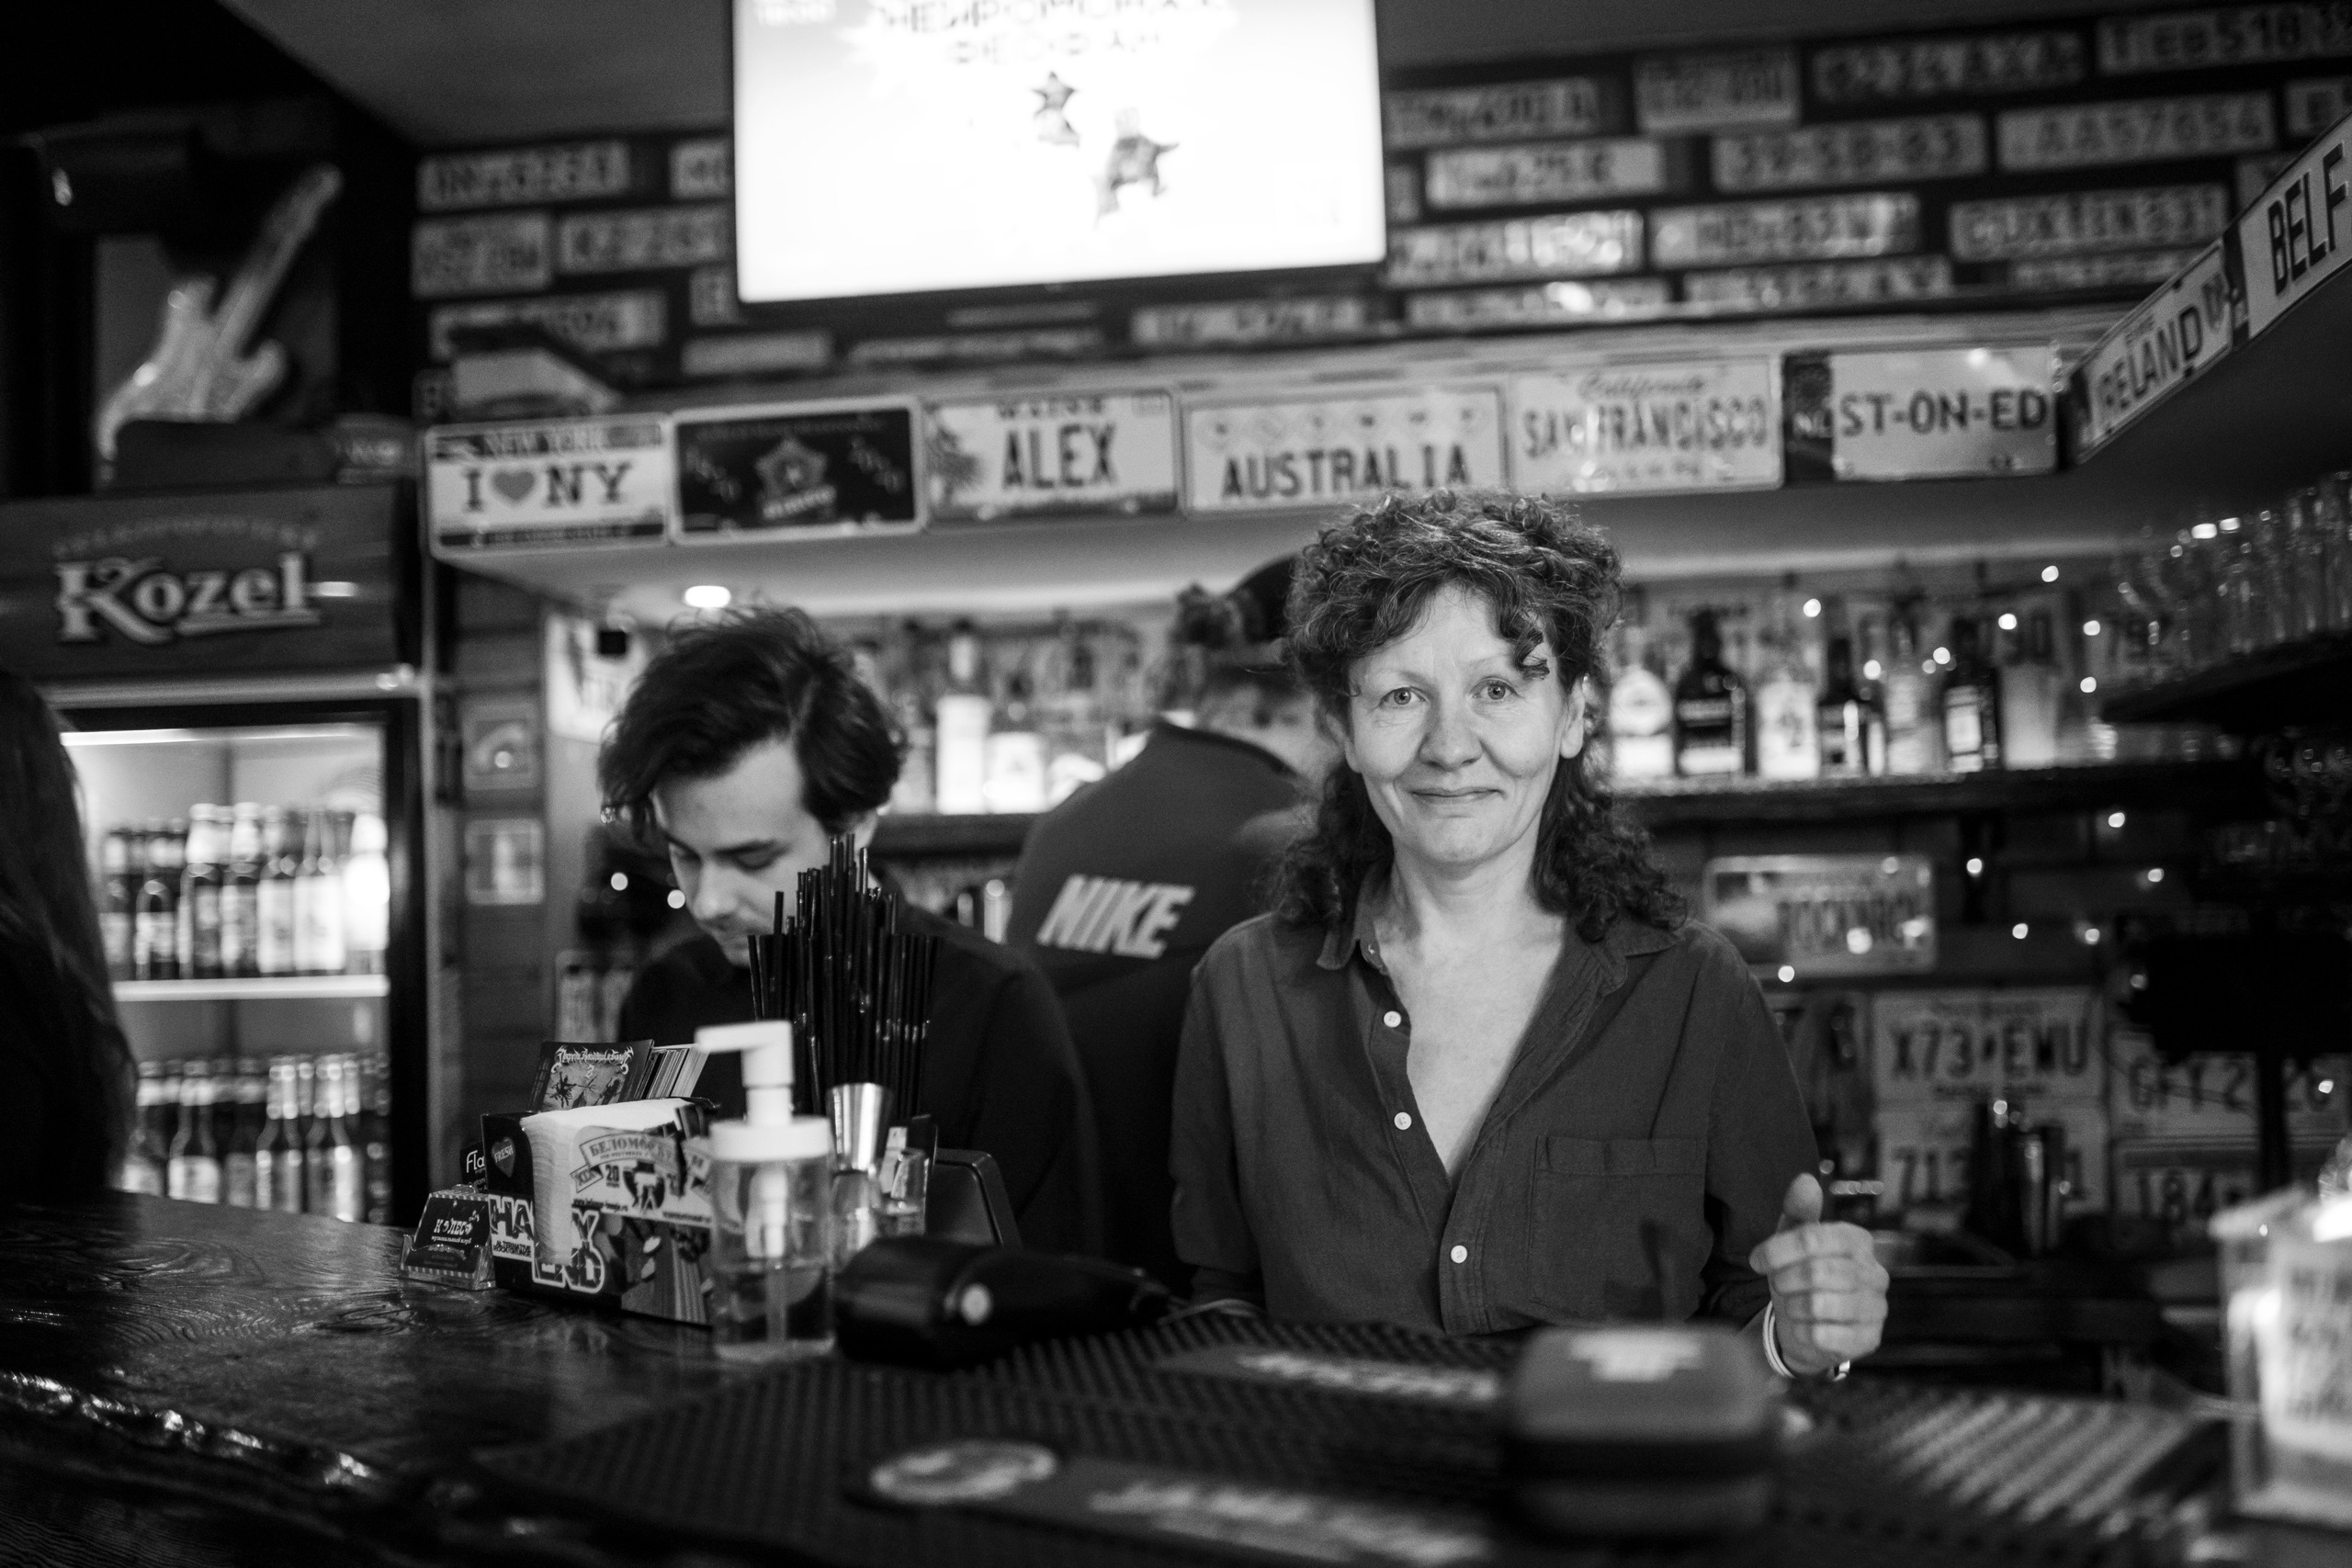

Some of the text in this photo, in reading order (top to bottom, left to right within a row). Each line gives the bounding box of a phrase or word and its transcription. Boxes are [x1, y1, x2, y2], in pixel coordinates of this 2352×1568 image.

[546, 460, 634, 507] NY
[1001, 423, 1118, 490] ALEX
[1221, 444, 1468, 499] AUSTRALIA
[55, 553, 317, 641] Kozel
[1036, 874, 1195, 959] NIKE
[605, 1164, 620, 1184] 20
